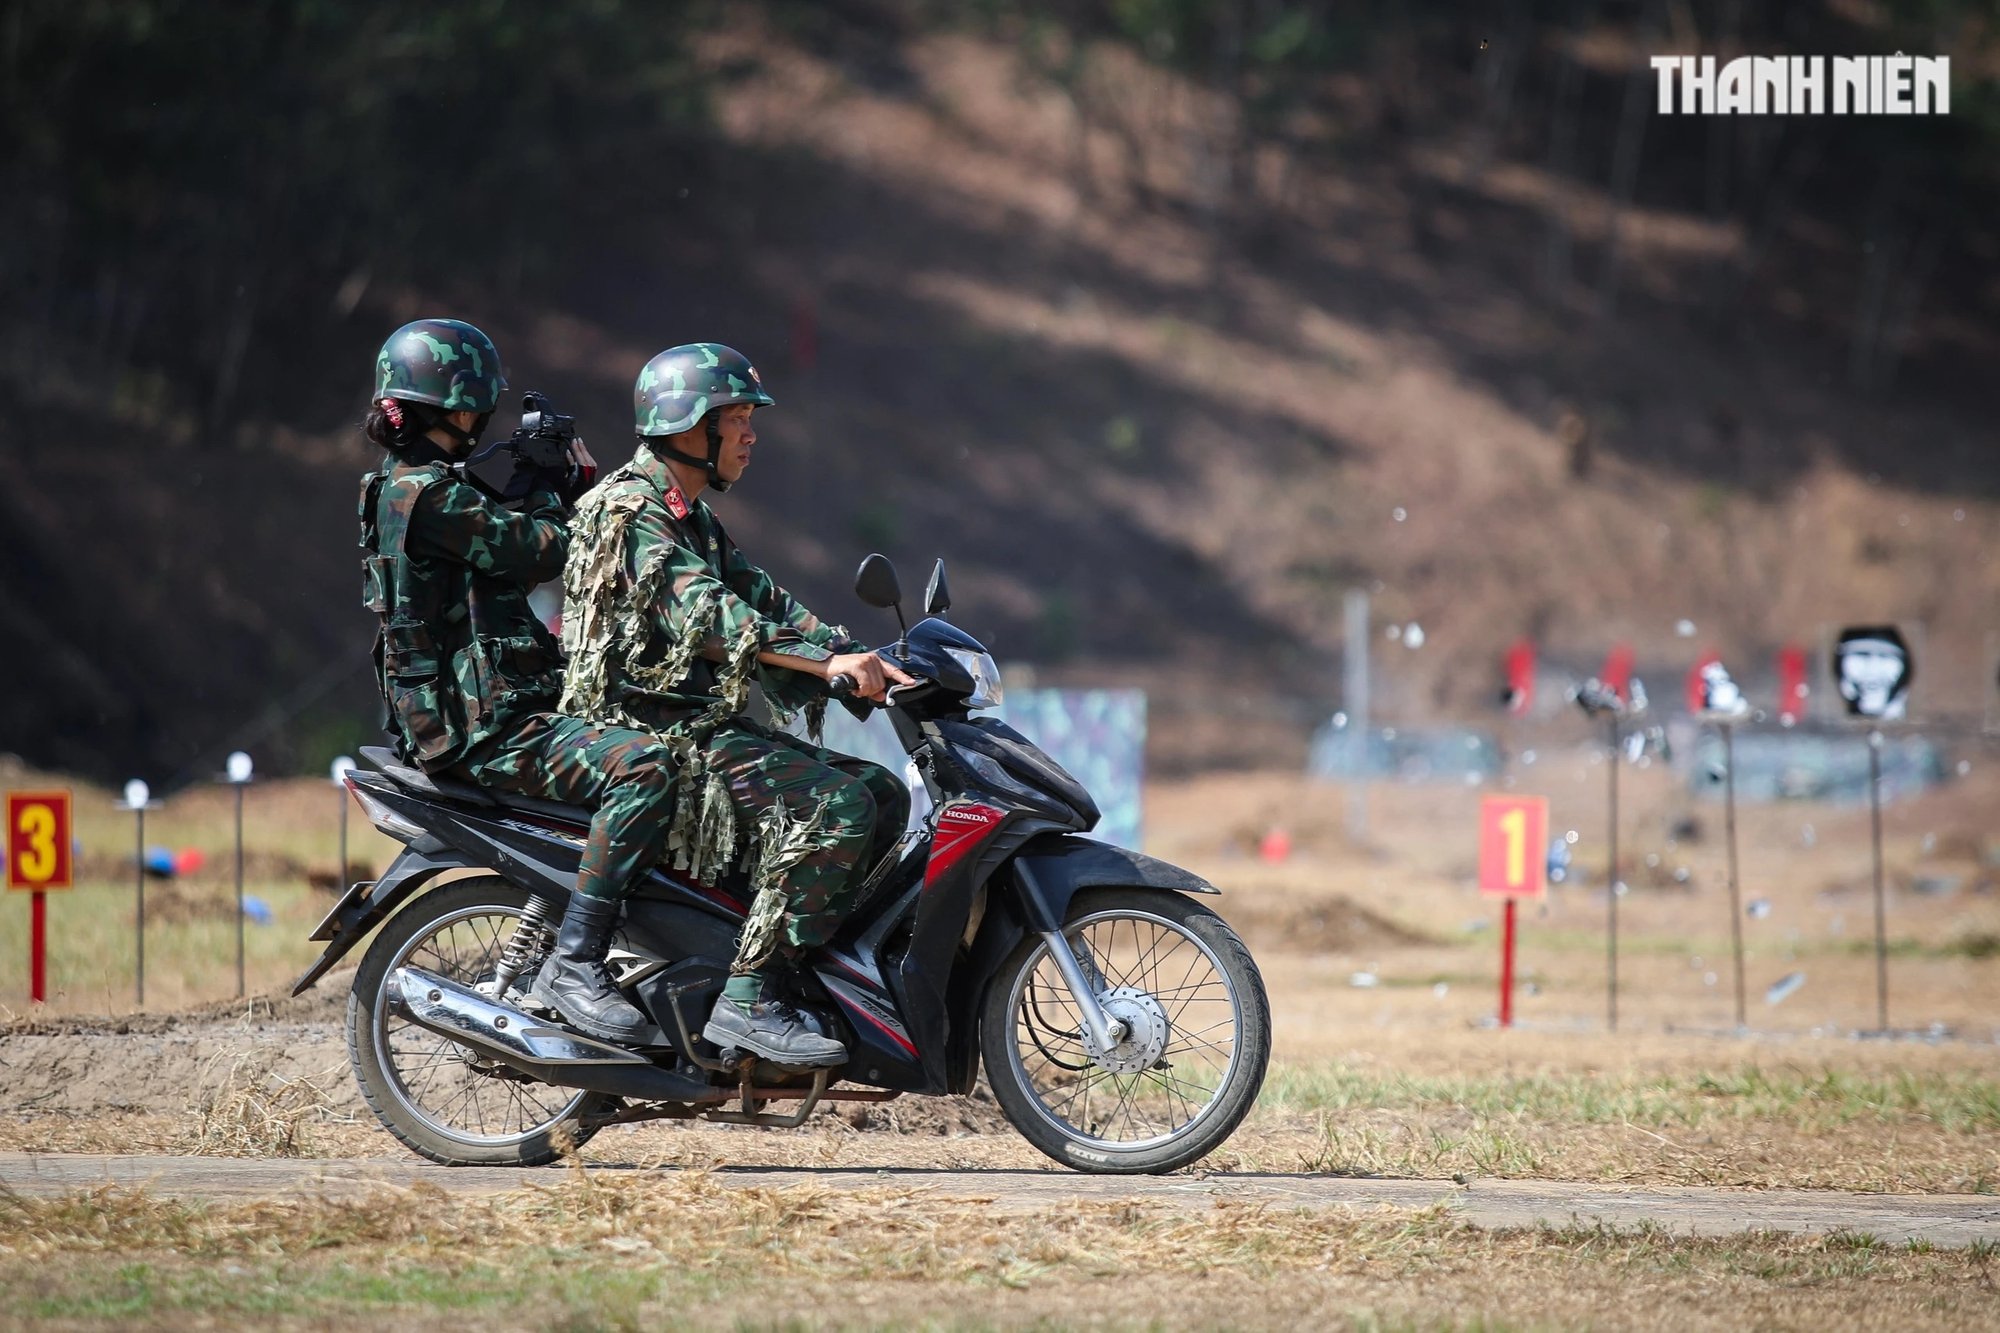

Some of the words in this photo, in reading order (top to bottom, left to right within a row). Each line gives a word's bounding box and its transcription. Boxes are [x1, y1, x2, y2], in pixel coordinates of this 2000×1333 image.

[18, 803, 57, 882] 3
[945, 810, 990, 823] HONDA
[1497, 807, 1527, 887] 1
